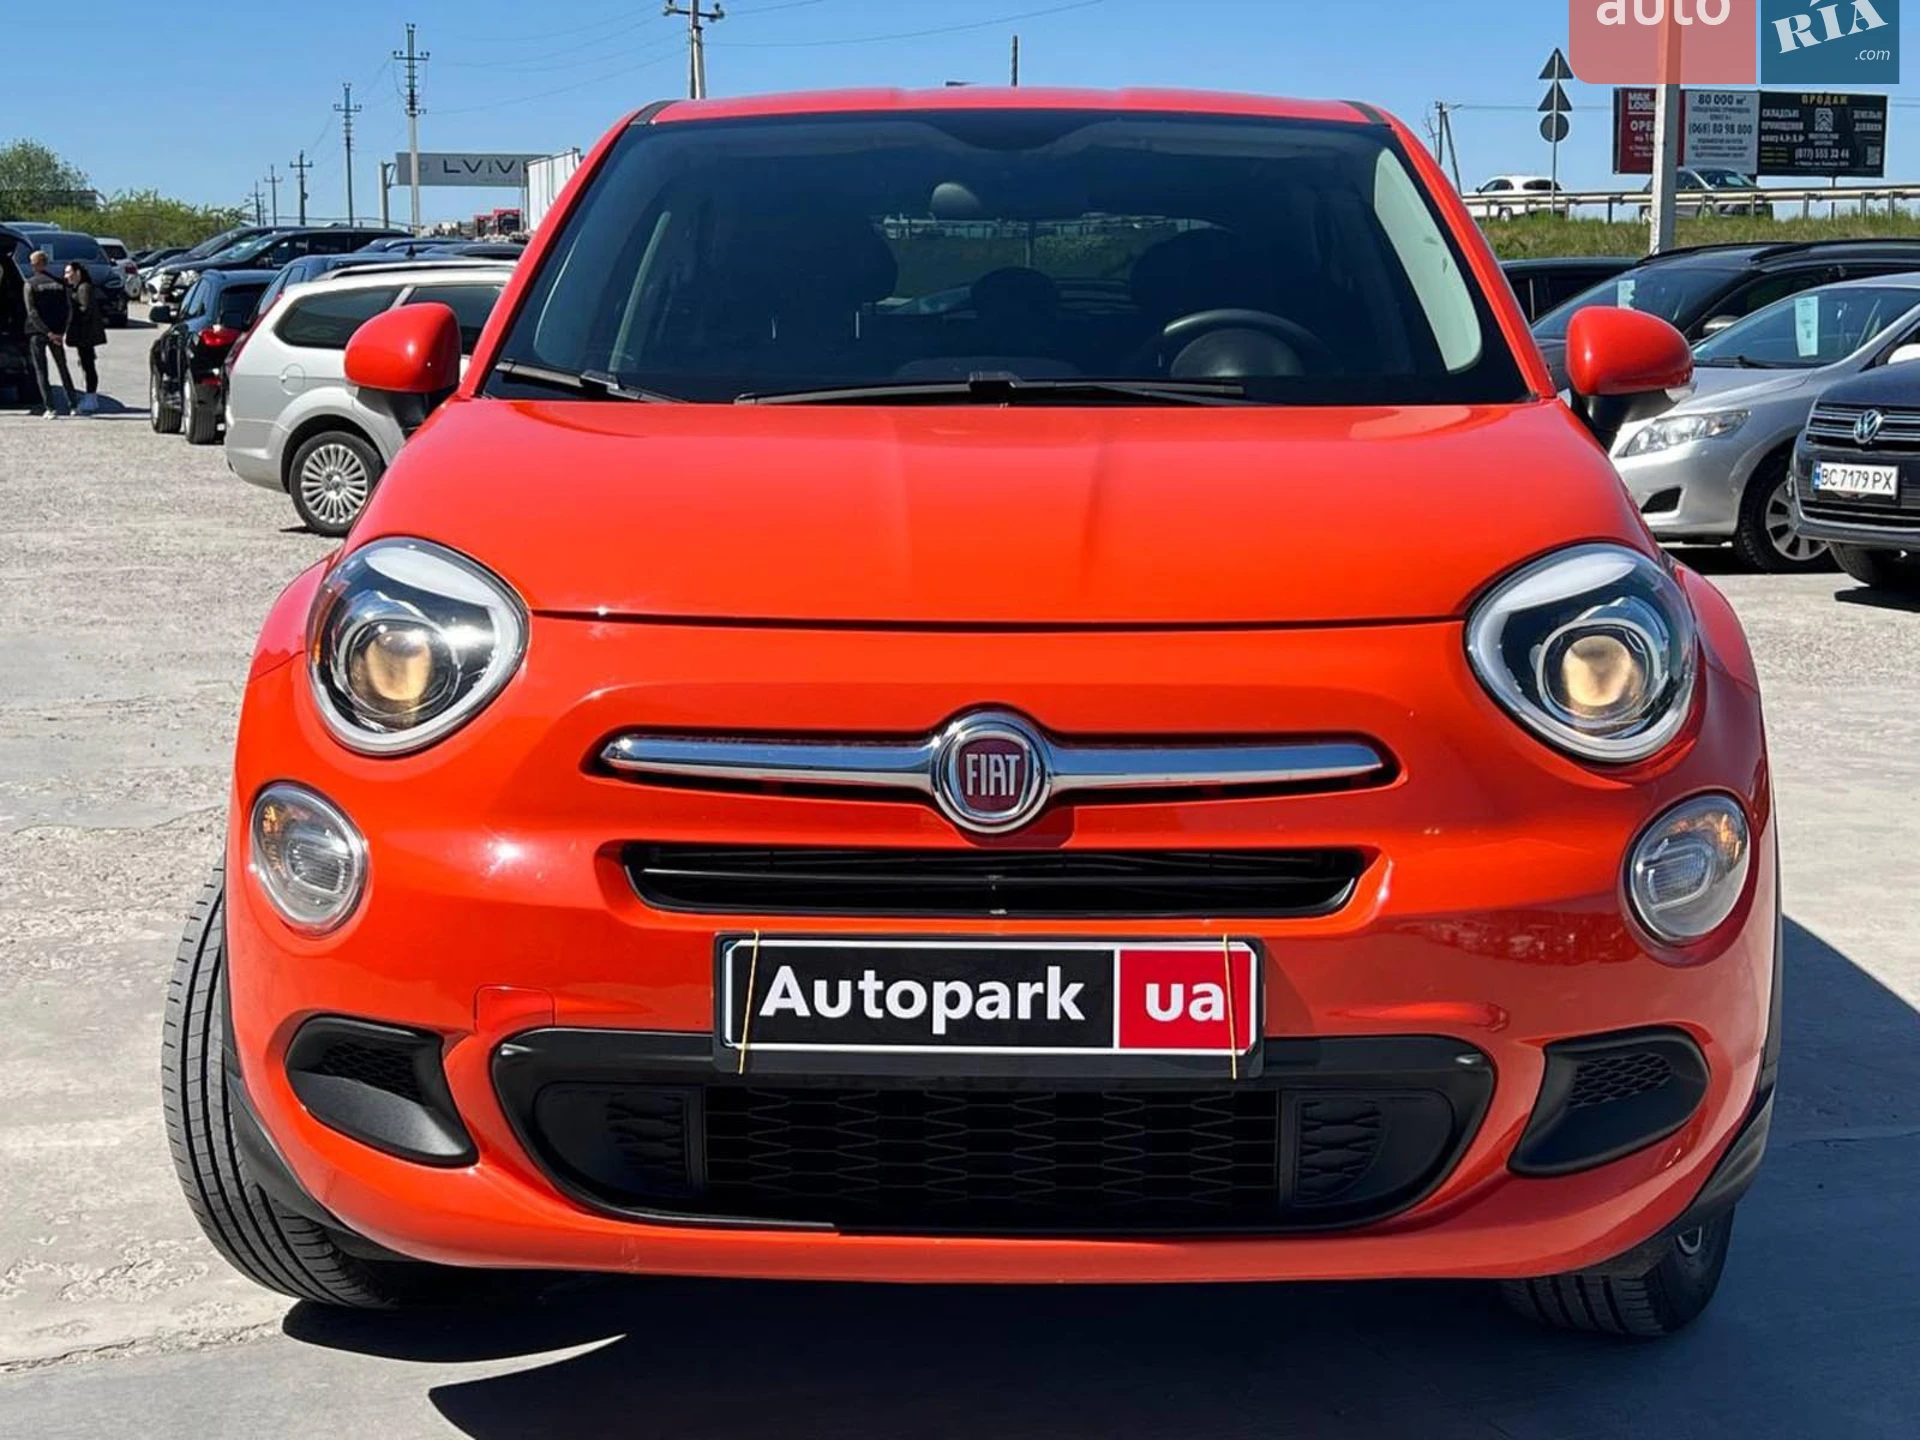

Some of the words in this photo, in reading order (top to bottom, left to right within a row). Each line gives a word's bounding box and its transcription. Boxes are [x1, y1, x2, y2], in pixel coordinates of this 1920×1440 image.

[1698, 94, 1711, 105] 80
[1714, 94, 1734, 105] 000
[1821, 468, 1837, 486] BC
[1839, 469, 1870, 489] 7179
[1872, 471, 1893, 491] PX
[965, 752, 1021, 797] FIAT
[759, 965, 1085, 1035] Autopark
[1145, 981, 1225, 1022] ua
